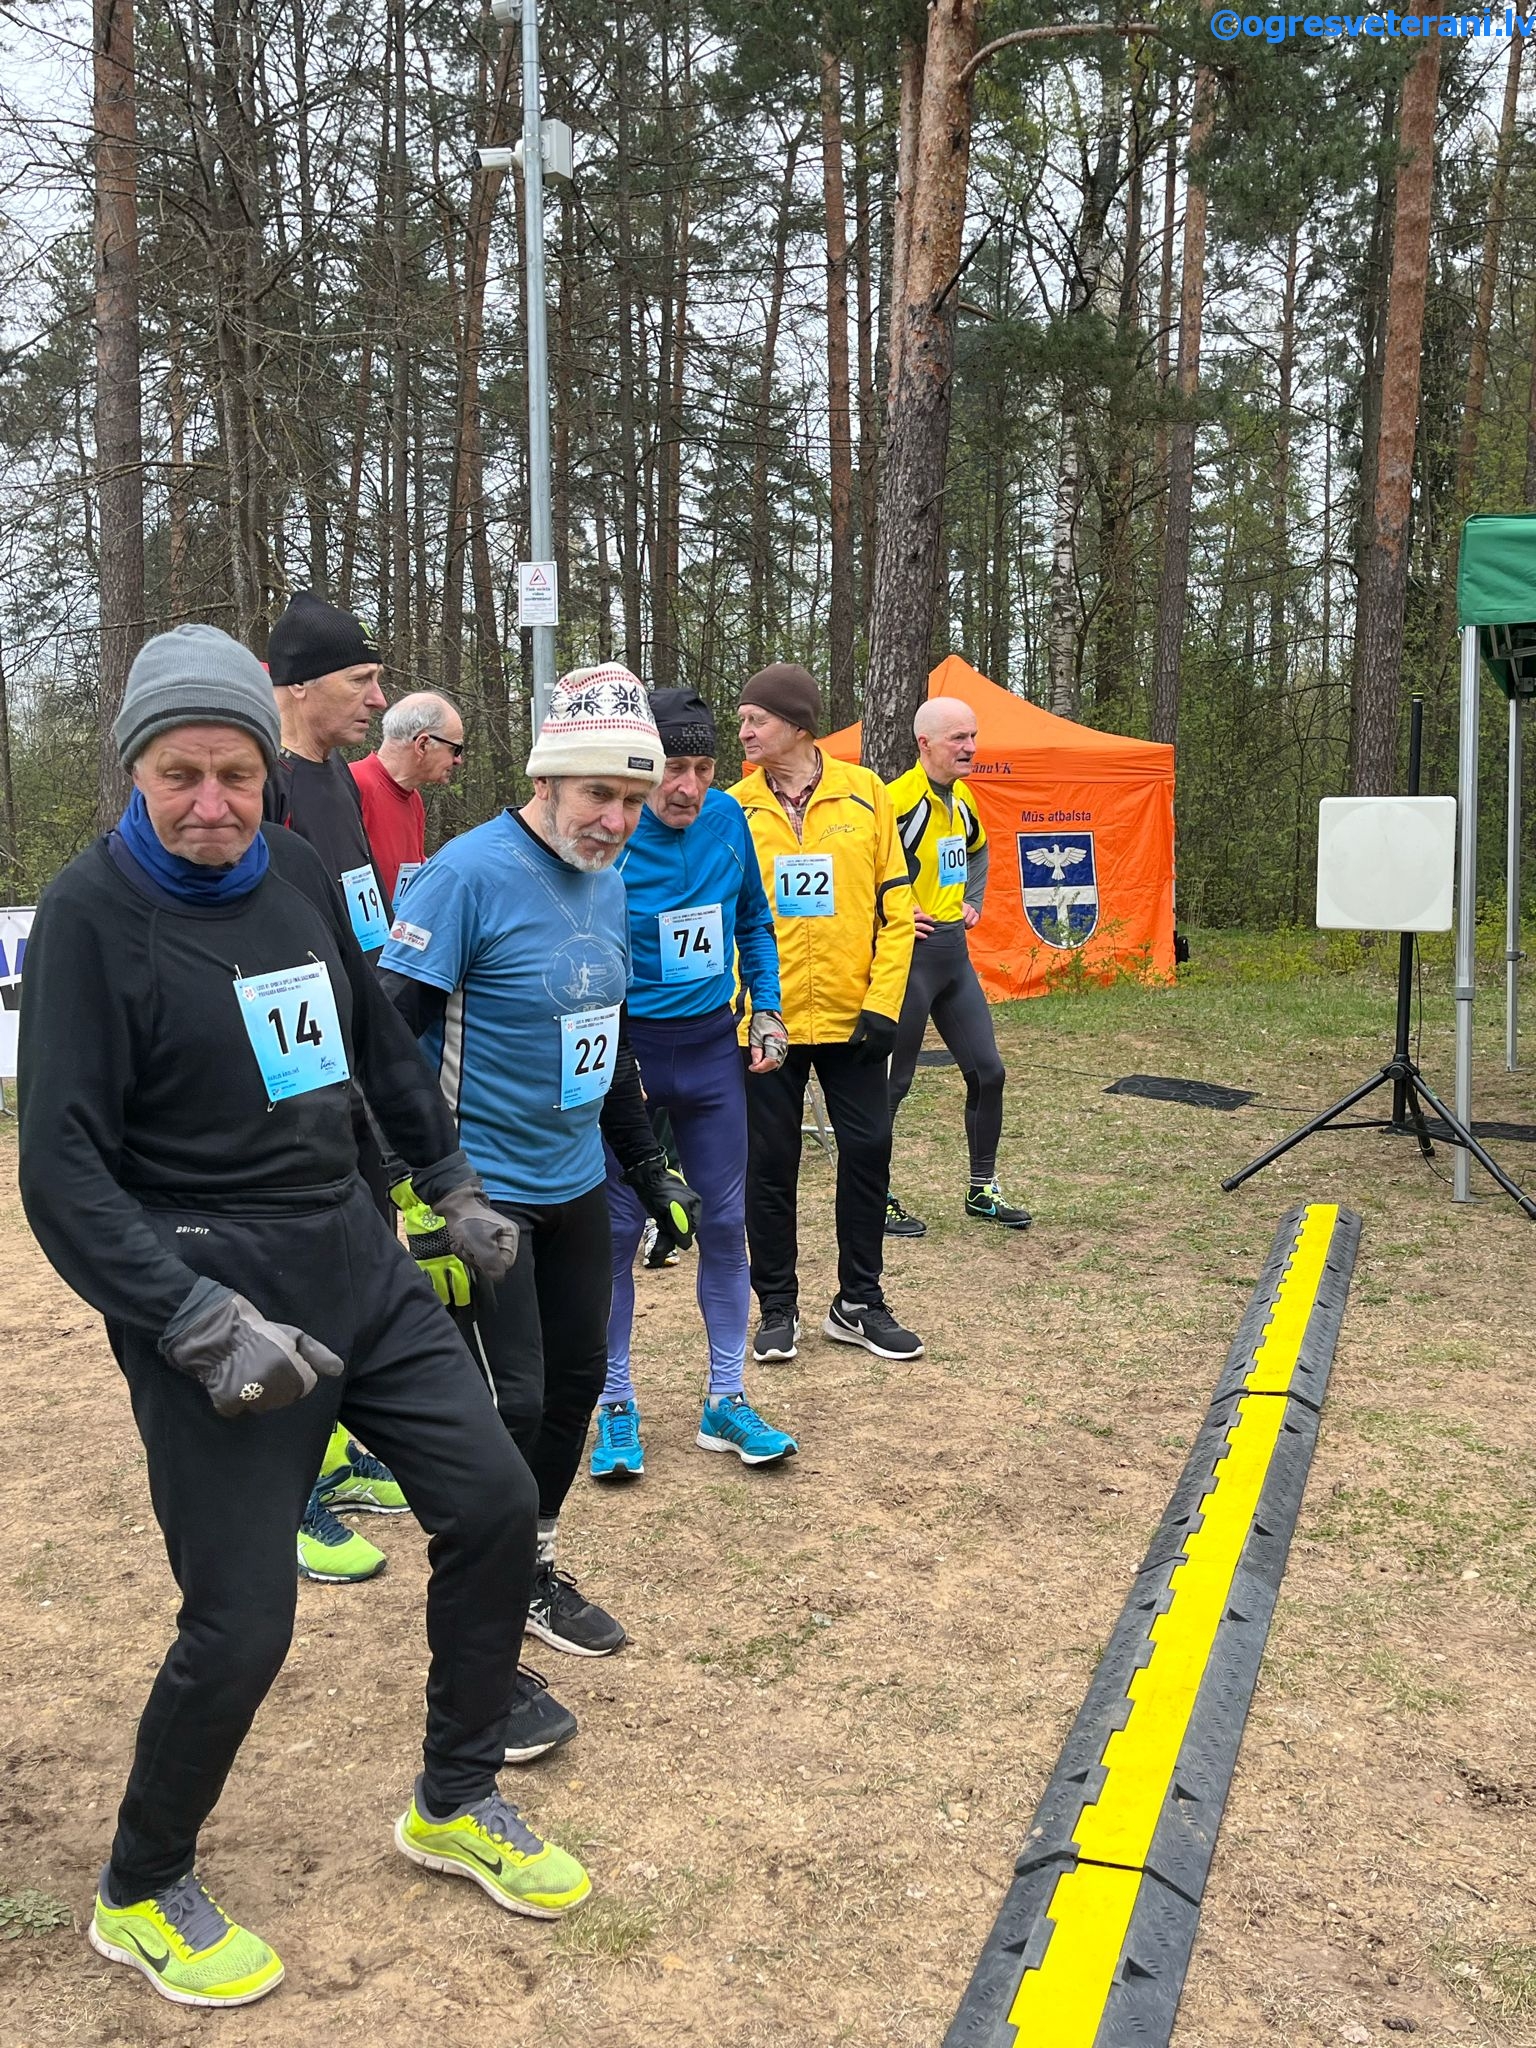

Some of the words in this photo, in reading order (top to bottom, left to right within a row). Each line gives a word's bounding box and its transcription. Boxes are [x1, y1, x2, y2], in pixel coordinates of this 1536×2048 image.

[1021, 810, 1045, 823] Mūs
[1048, 809, 1092, 822] atbalsta
[941, 848, 966, 871] 100
[780, 871, 830, 897] 122
[357, 887, 380, 923] 19
[673, 926, 712, 958] 74
[267, 1000, 323, 1055] 14
[574, 1034, 608, 1077] 22
